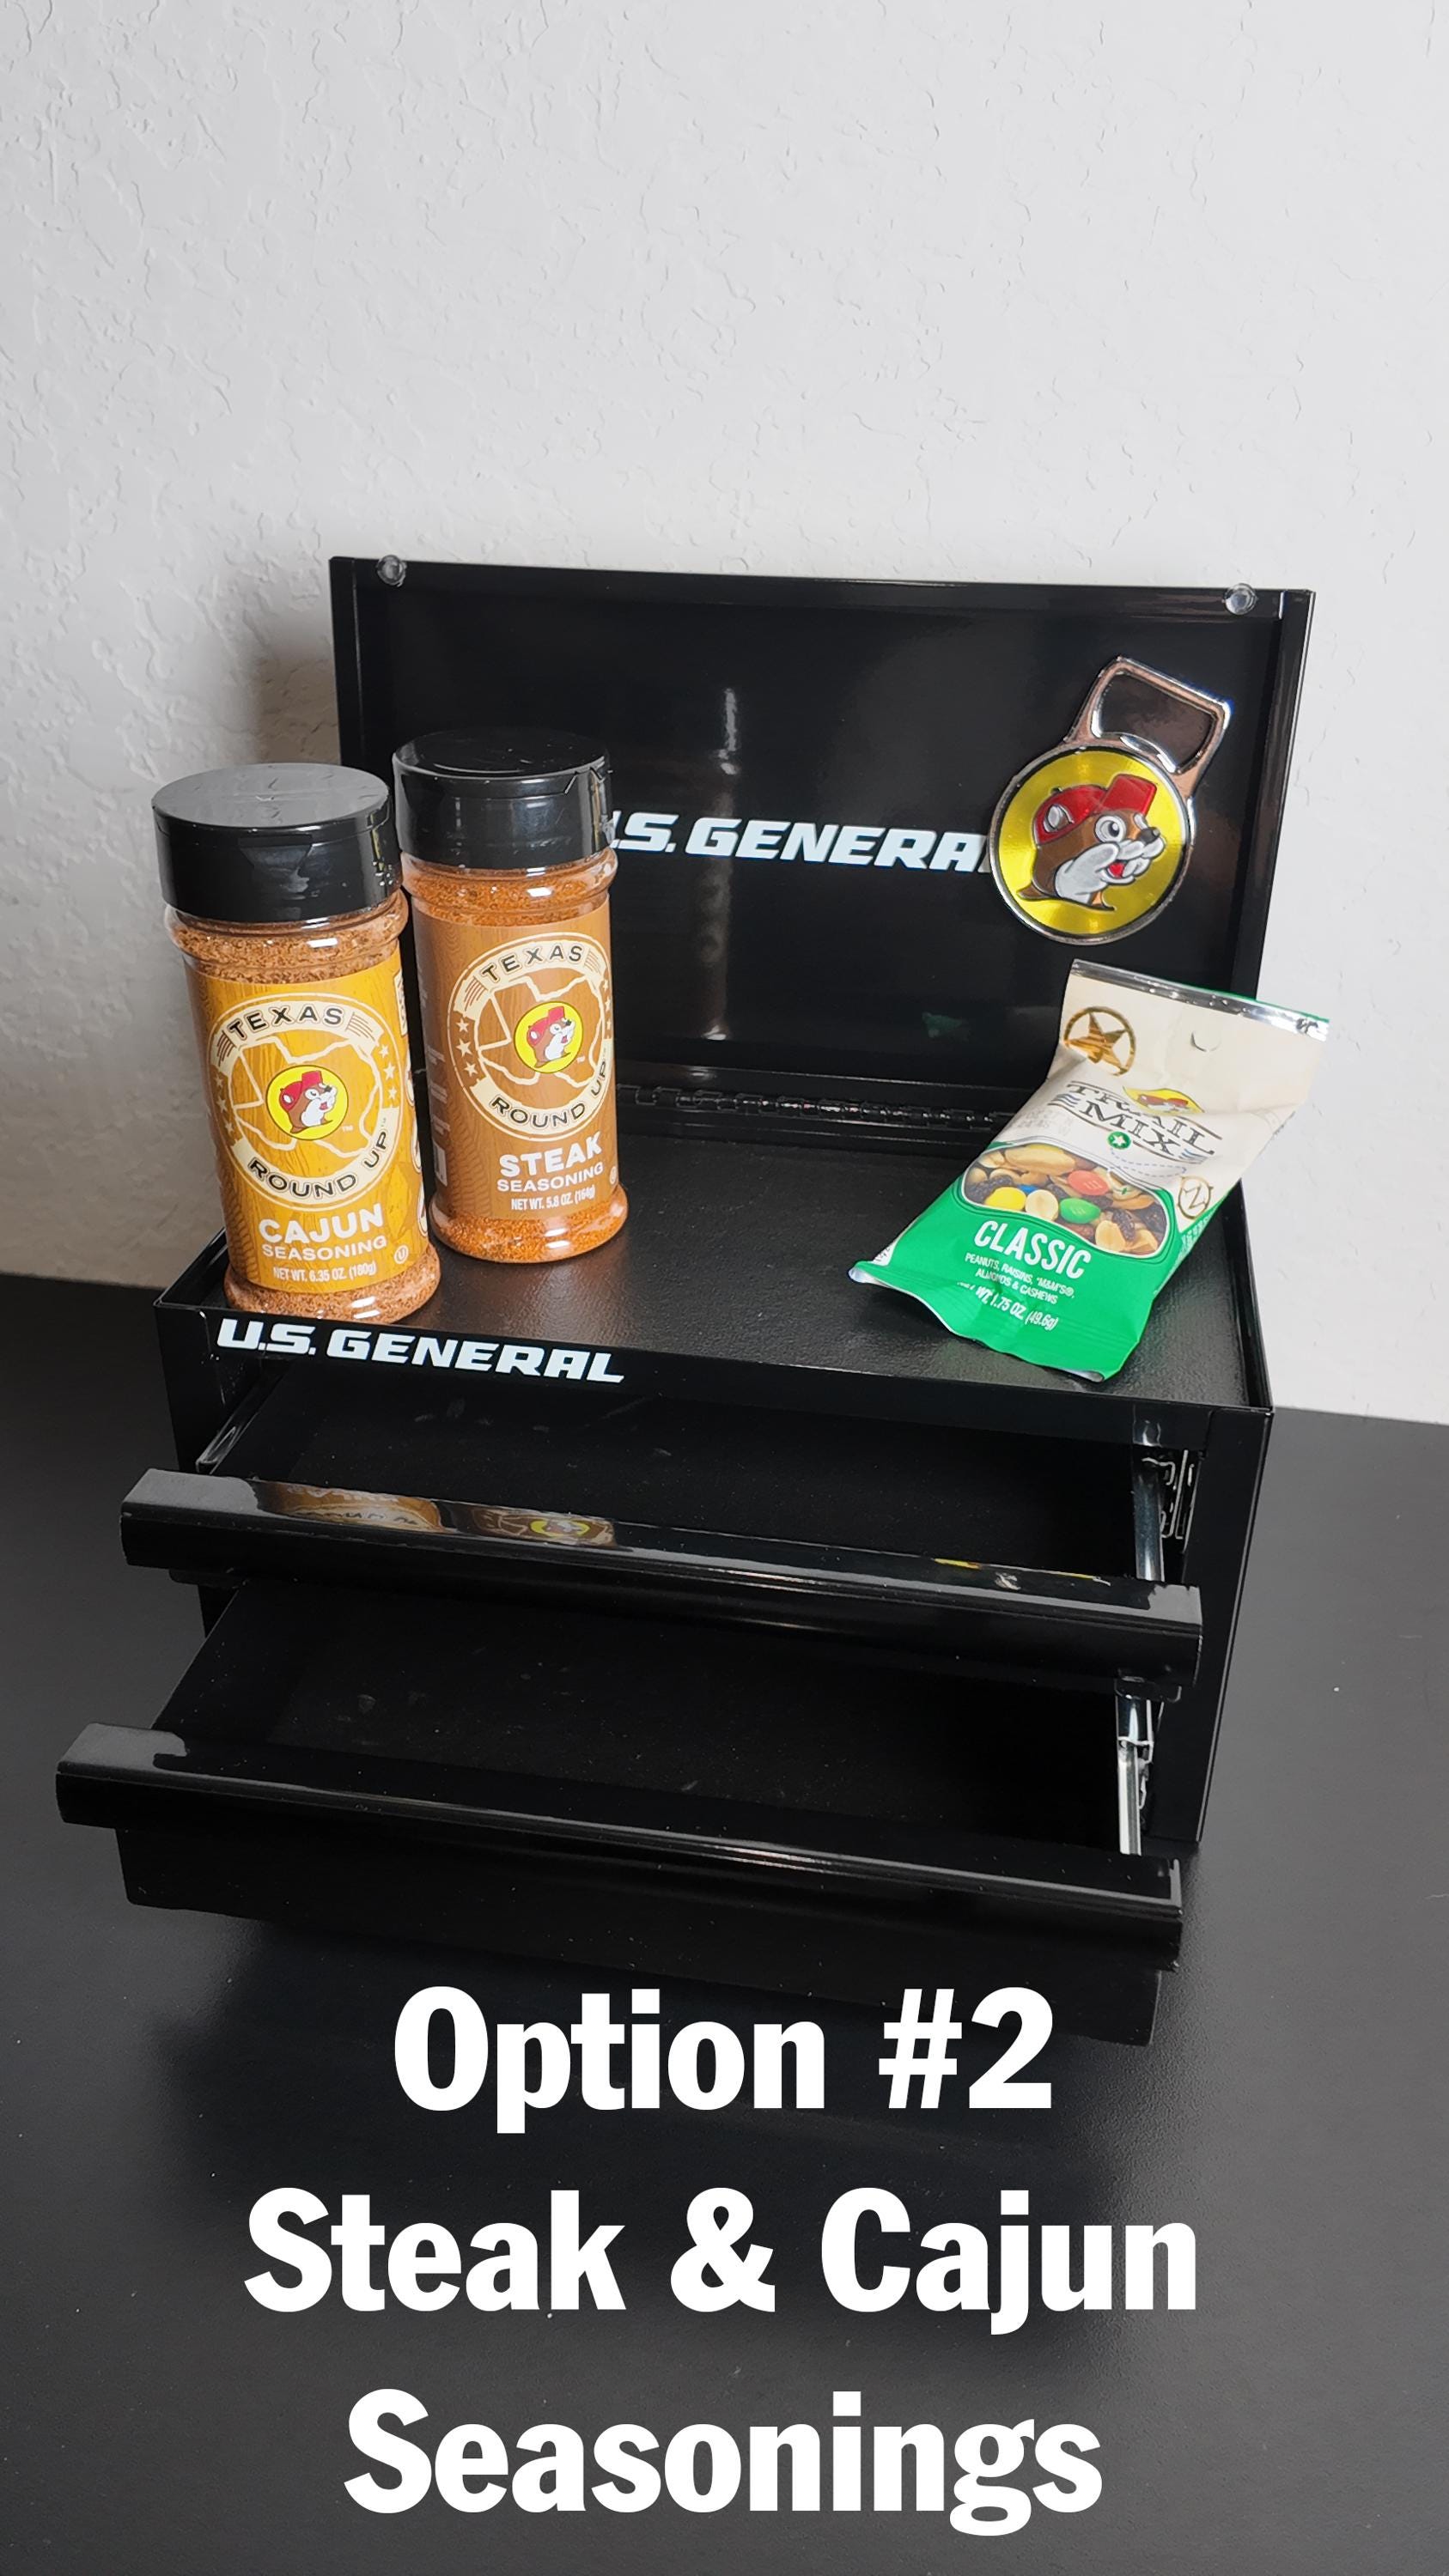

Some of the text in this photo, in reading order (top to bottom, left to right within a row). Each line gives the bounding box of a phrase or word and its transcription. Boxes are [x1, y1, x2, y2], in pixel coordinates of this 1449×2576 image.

[685, 817, 994, 873] GENERA
[482, 945, 583, 982] TEXAS
[228, 1006, 344, 1038] TEXAS
[490, 1097, 586, 1128] ROUND
[590, 1060, 607, 1097] UP
[1079, 1100, 1181, 1157] MIX
[249, 1131, 387, 1198] ROUND UP
[499, 1131, 602, 1177] STEAK
[496, 1161, 604, 1192] SEASONING
[510, 1198, 527, 1211] NET
[529, 1198, 545, 1211] WT.
[546, 1196, 558, 1208] 5.8
[561, 1193, 574, 1206] OZ.
[259, 1202, 384, 1244] CAJUN
[262, 1235, 387, 1261] SEASONING
[974, 1220, 1092, 1279] CLASSIC
[273, 1261, 377, 1283] NET WT. 6.35 OZ. (180g)
[965, 1253, 1000, 1271] PEANUTS,
[1001, 1262, 1033, 1285] RAISINS,
[1012, 1279, 1020, 1291] &
[1020, 1284, 1058, 1305] CASHEWS
[990, 1293, 1013, 1311] 1.75
[1025, 1310, 1059, 1331] (49.6g)
[216, 1318, 624, 1383] U.S. GENERAL
